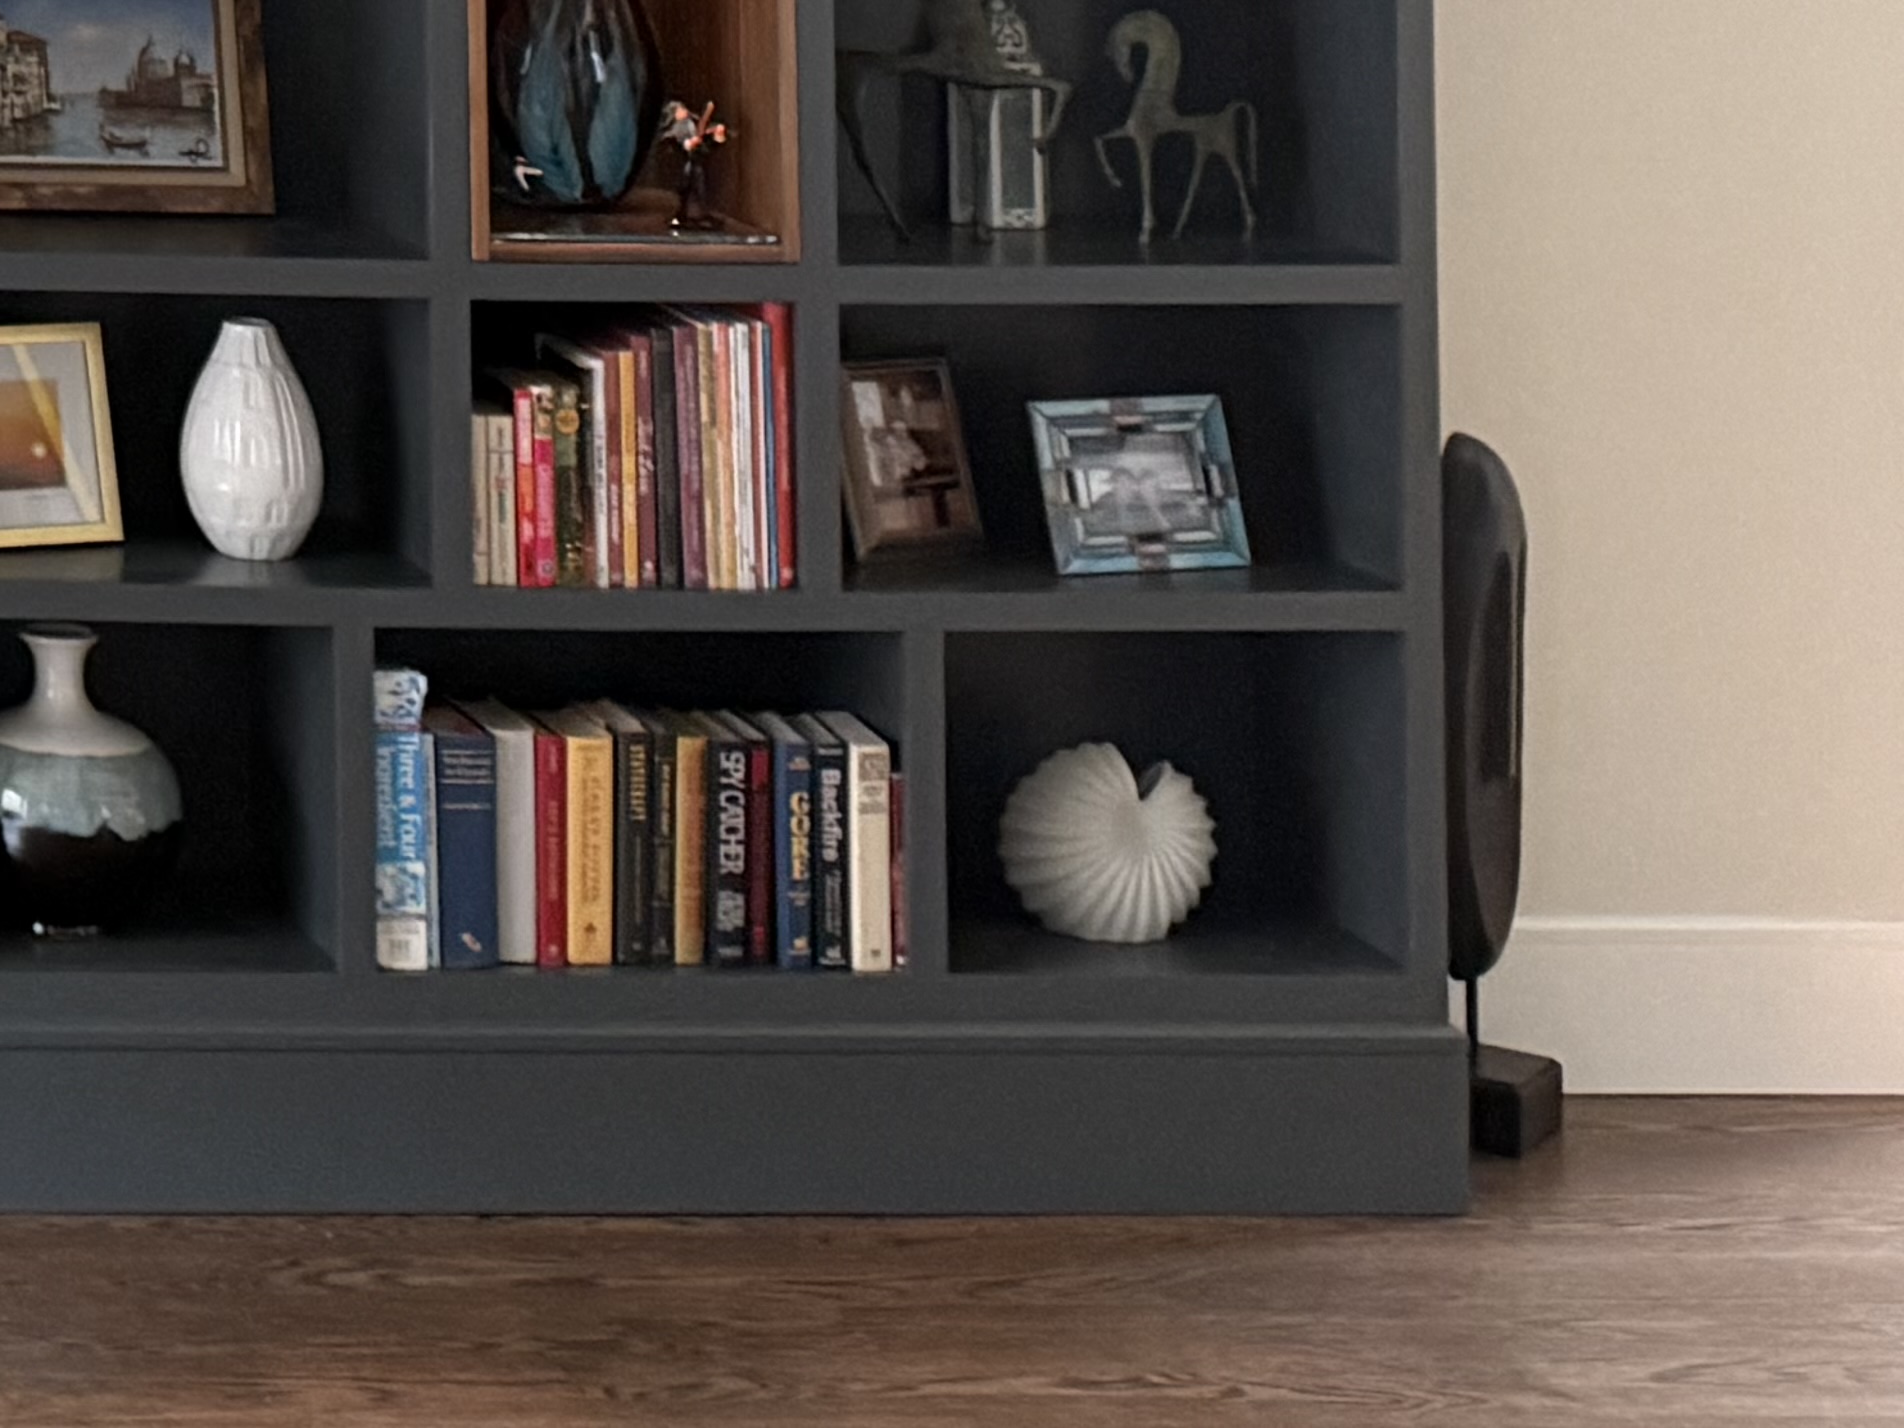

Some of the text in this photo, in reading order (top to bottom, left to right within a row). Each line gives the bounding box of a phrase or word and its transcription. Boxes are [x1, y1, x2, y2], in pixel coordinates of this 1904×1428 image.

[398, 735, 420, 859] Three & Four
[821, 768, 844, 862] Backfire
